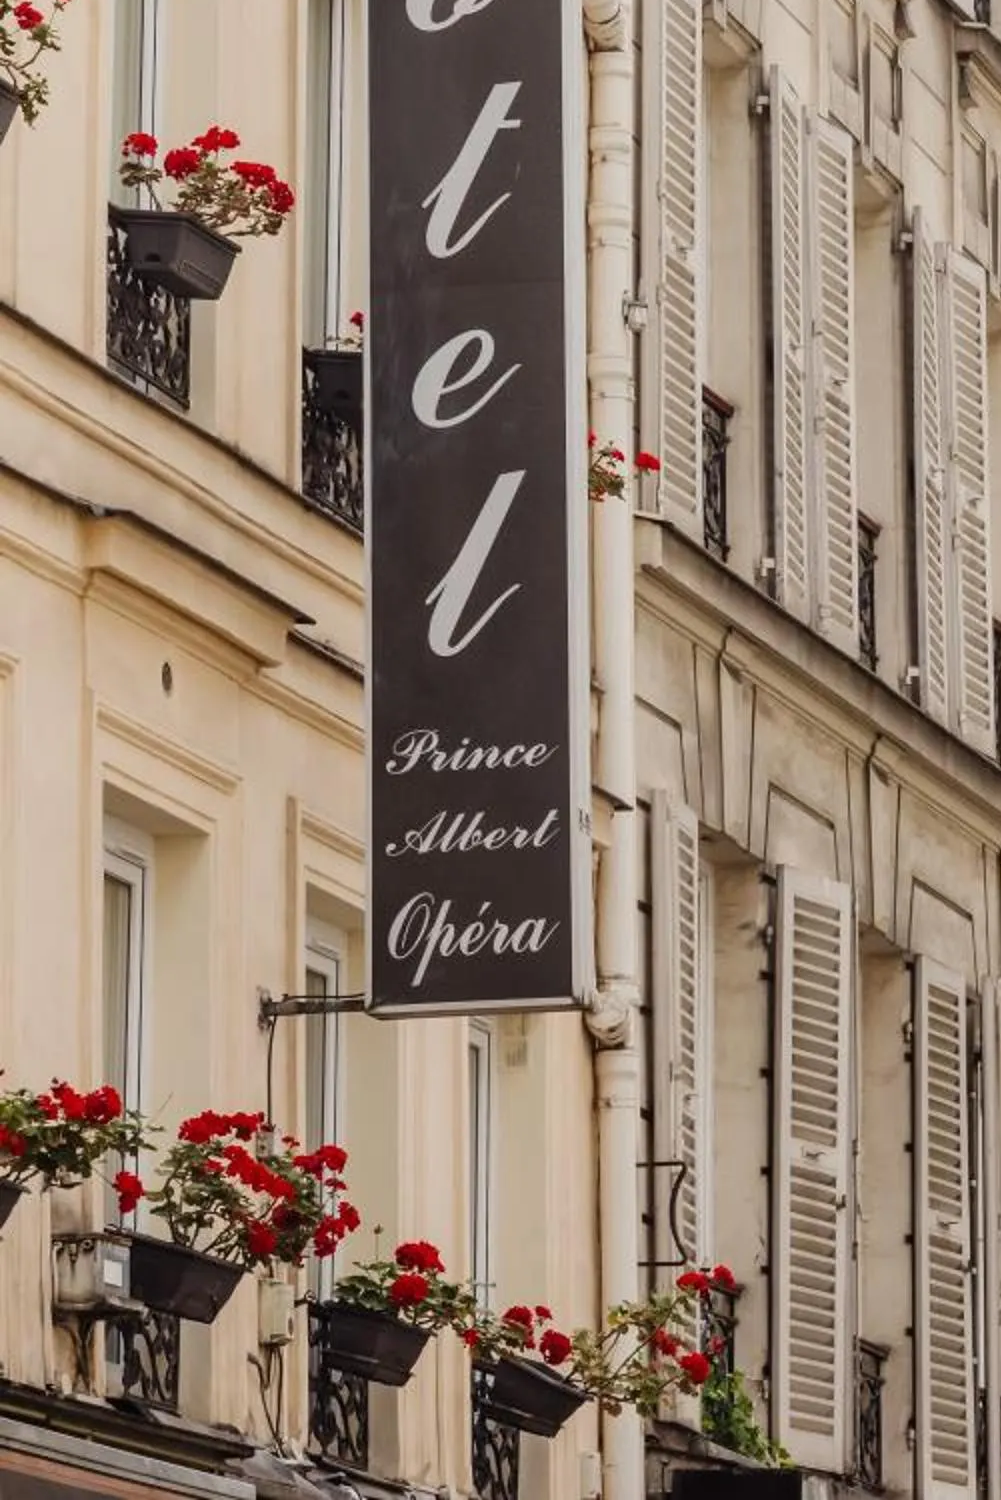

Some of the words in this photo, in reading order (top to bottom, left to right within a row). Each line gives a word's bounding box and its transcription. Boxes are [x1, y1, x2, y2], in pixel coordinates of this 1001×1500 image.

[386, 729, 560, 775] Prince
[385, 808, 561, 857] Albert
[387, 891, 561, 987] Opéra
